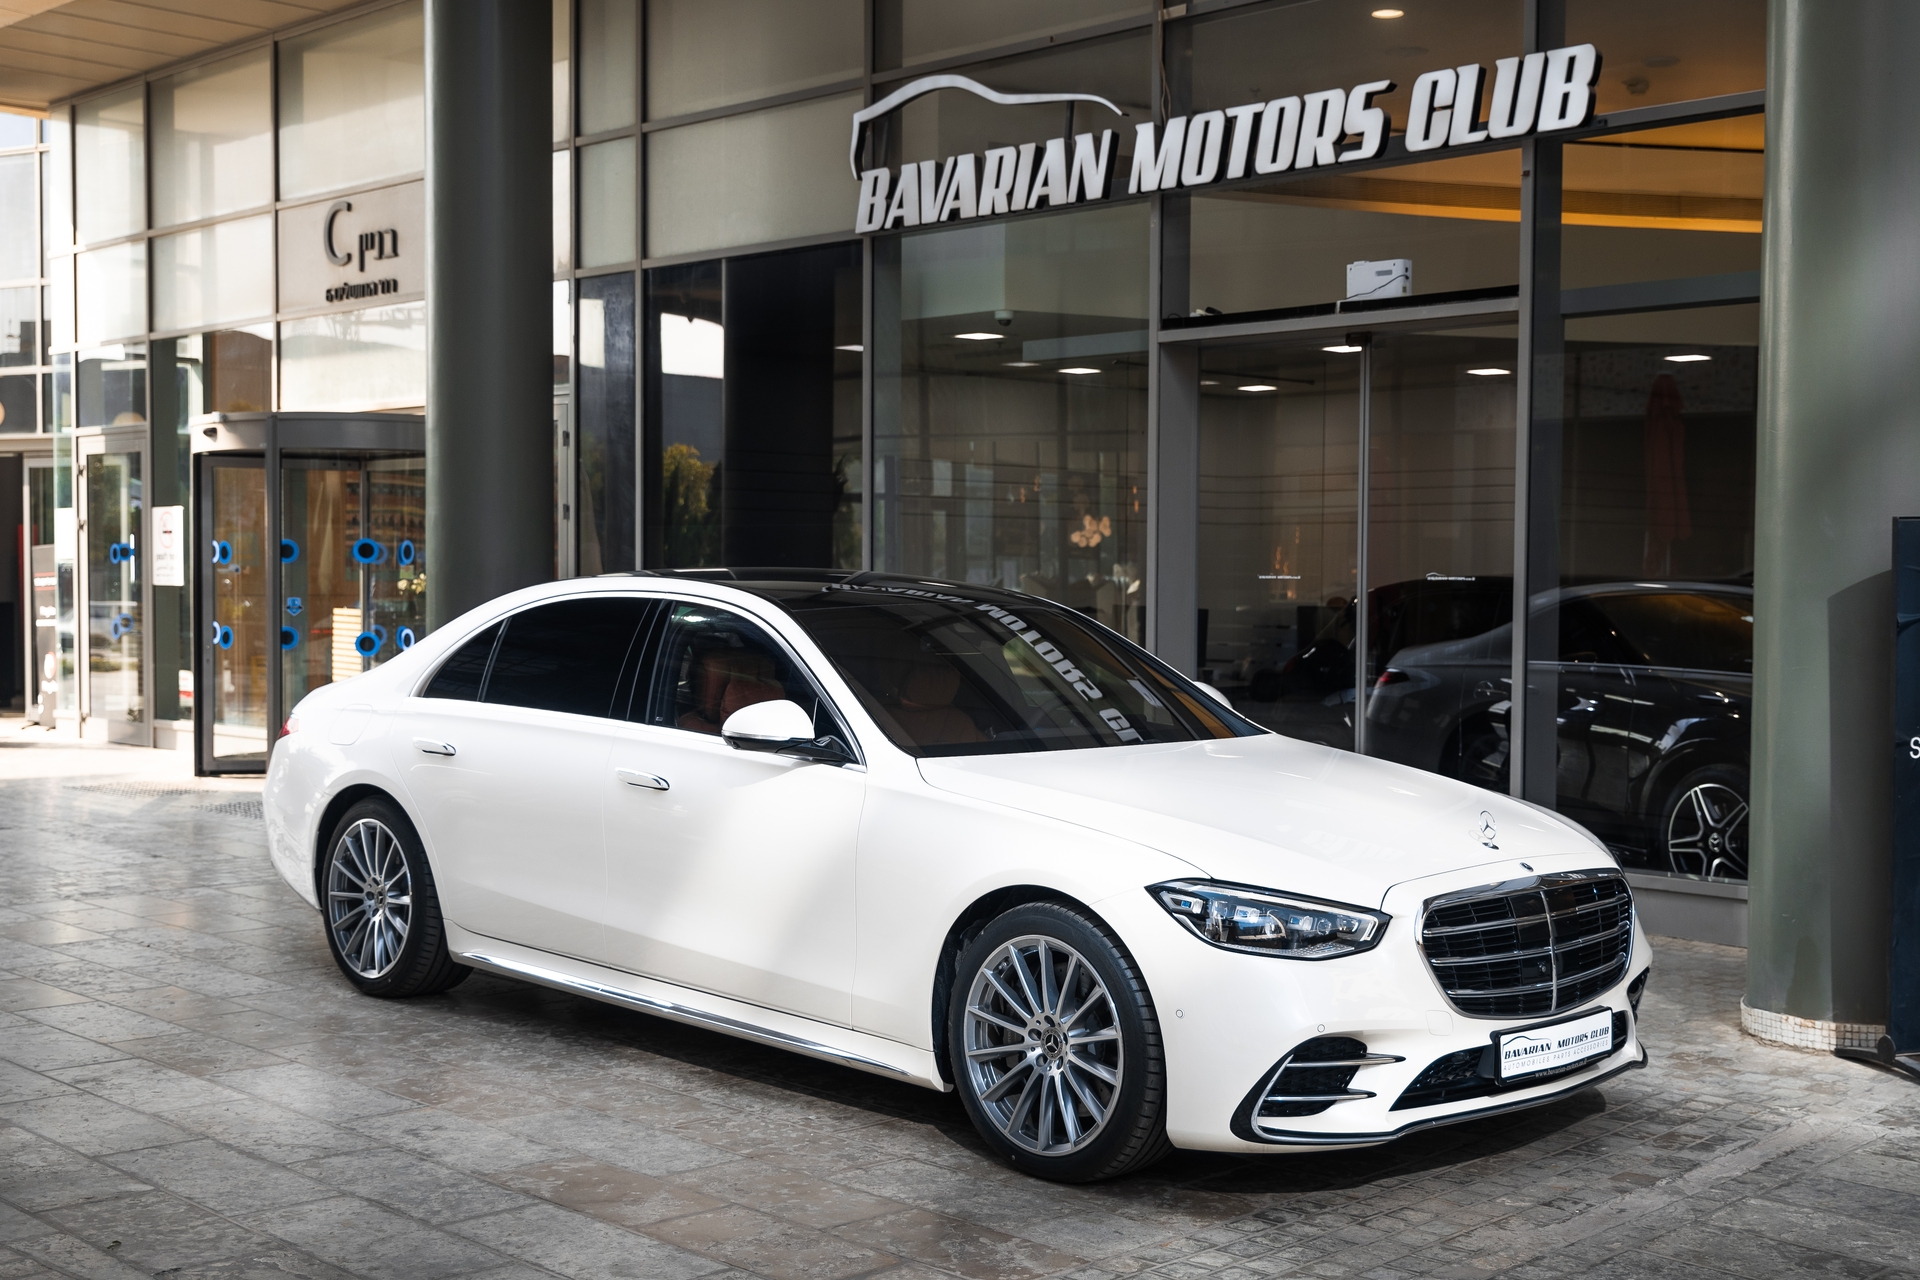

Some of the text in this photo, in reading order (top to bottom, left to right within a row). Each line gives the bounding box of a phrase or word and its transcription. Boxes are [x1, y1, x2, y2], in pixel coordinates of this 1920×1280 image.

[855, 43, 1602, 234] BAVARIAN MOTORS CLUB
[323, 200, 399, 273] בניין C
[1503, 1039, 1609, 1072] AUTOMOBILES PARTS ACCESSORIES
[1504, 1026, 1610, 1060] BAVARIAN MOTORS CLUB
